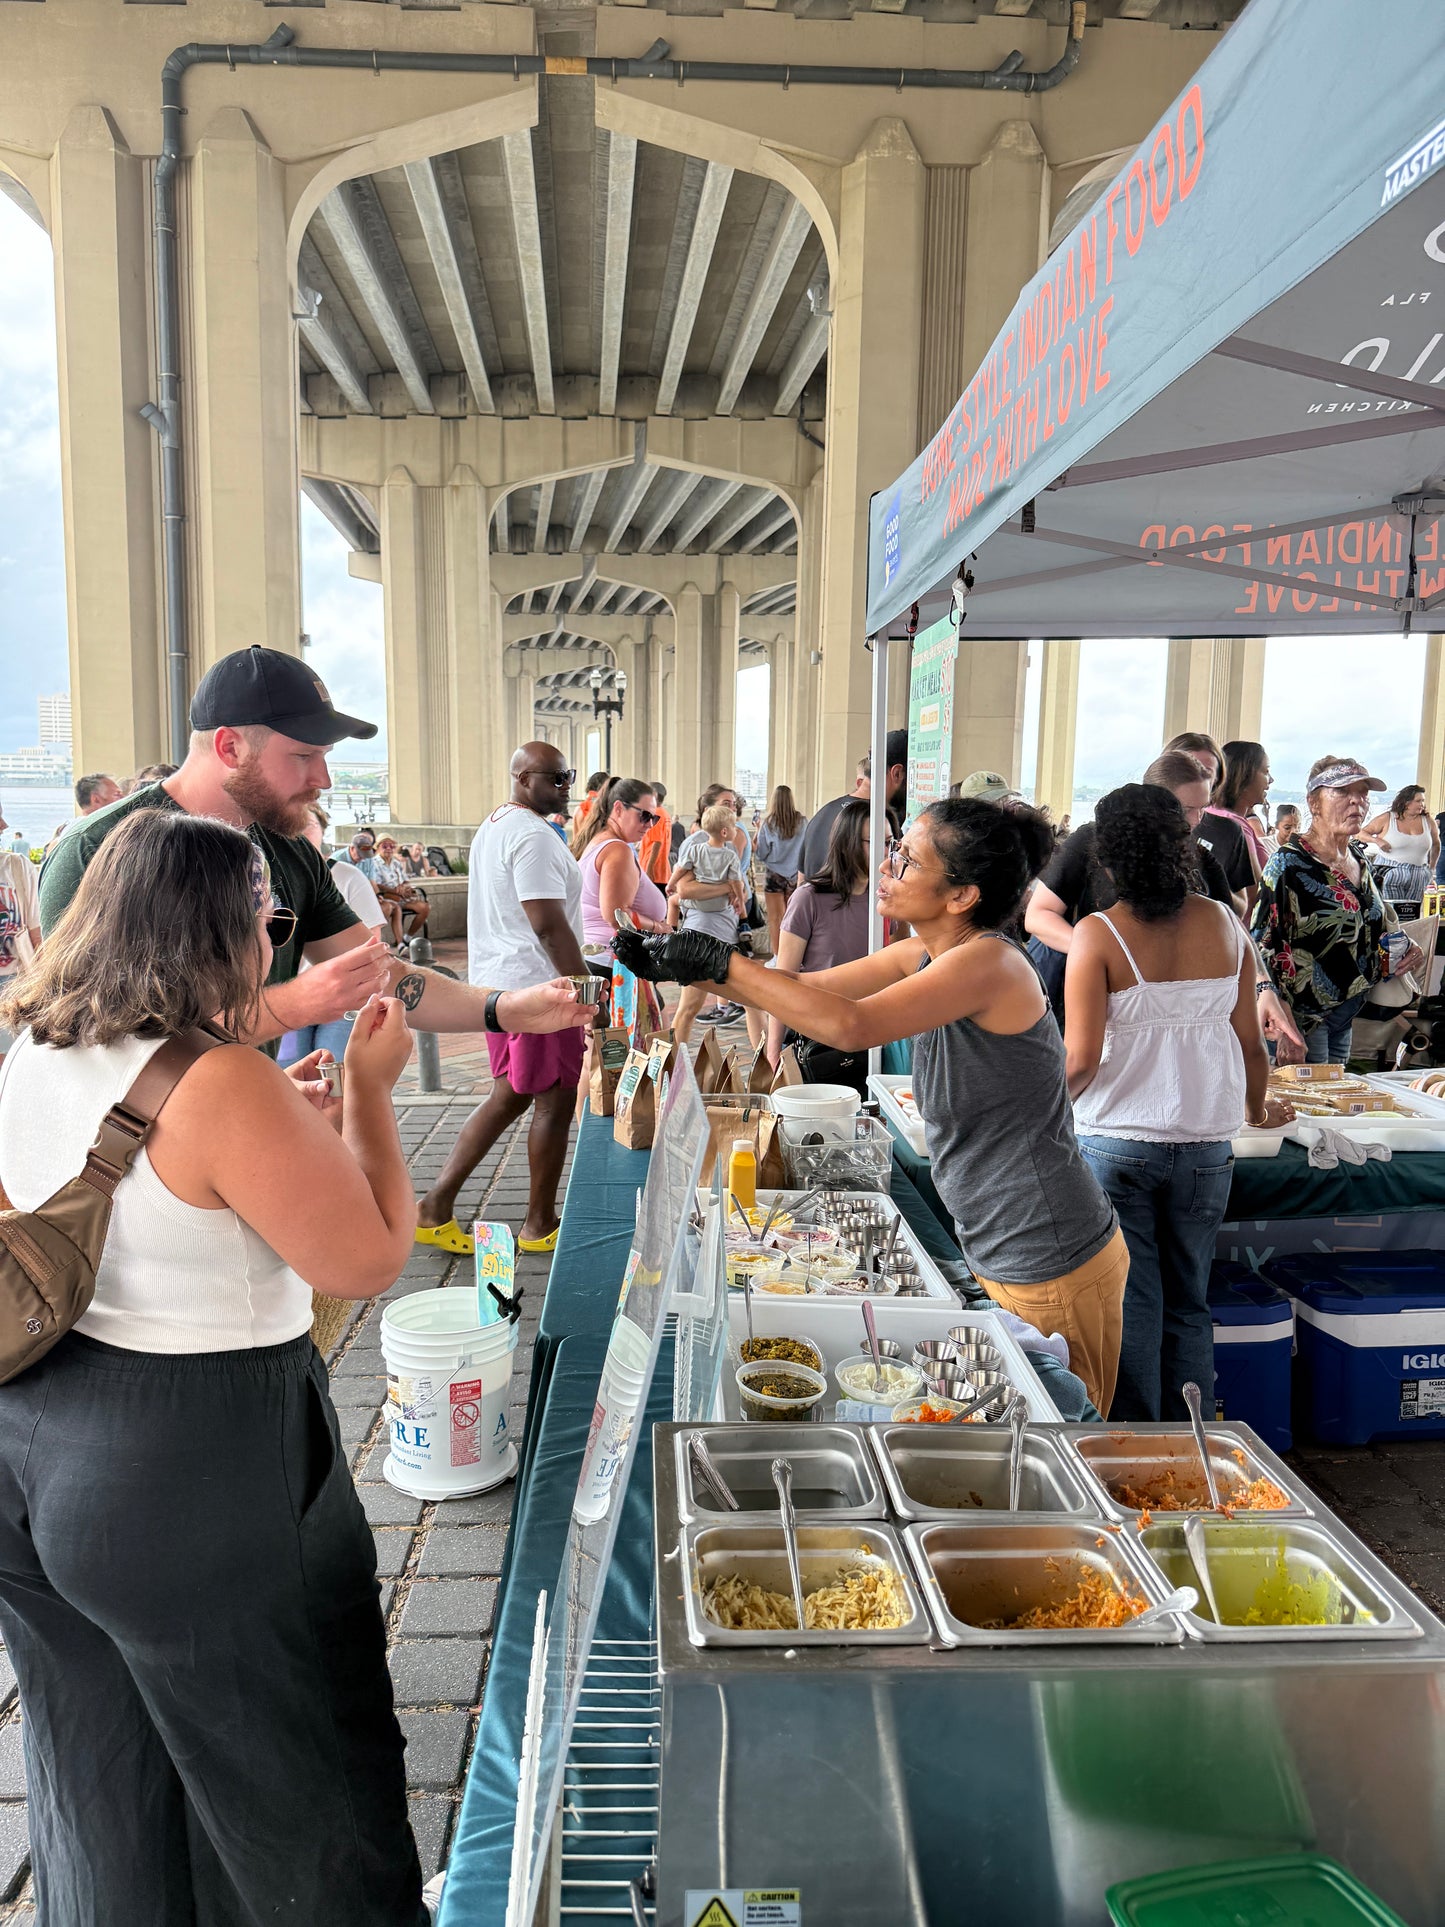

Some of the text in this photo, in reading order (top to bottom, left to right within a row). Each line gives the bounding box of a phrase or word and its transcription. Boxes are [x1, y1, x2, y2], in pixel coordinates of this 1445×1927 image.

[1017, 215, 1097, 387] INDIAN
[1106, 84, 1204, 286] FOOD
[943, 294, 1114, 539] MADE WITH LOVE
[456, 1381, 480, 1390] WARNING
[390, 1421, 431, 1449] RE
[761, 1893, 795, 1901] CAUTION
